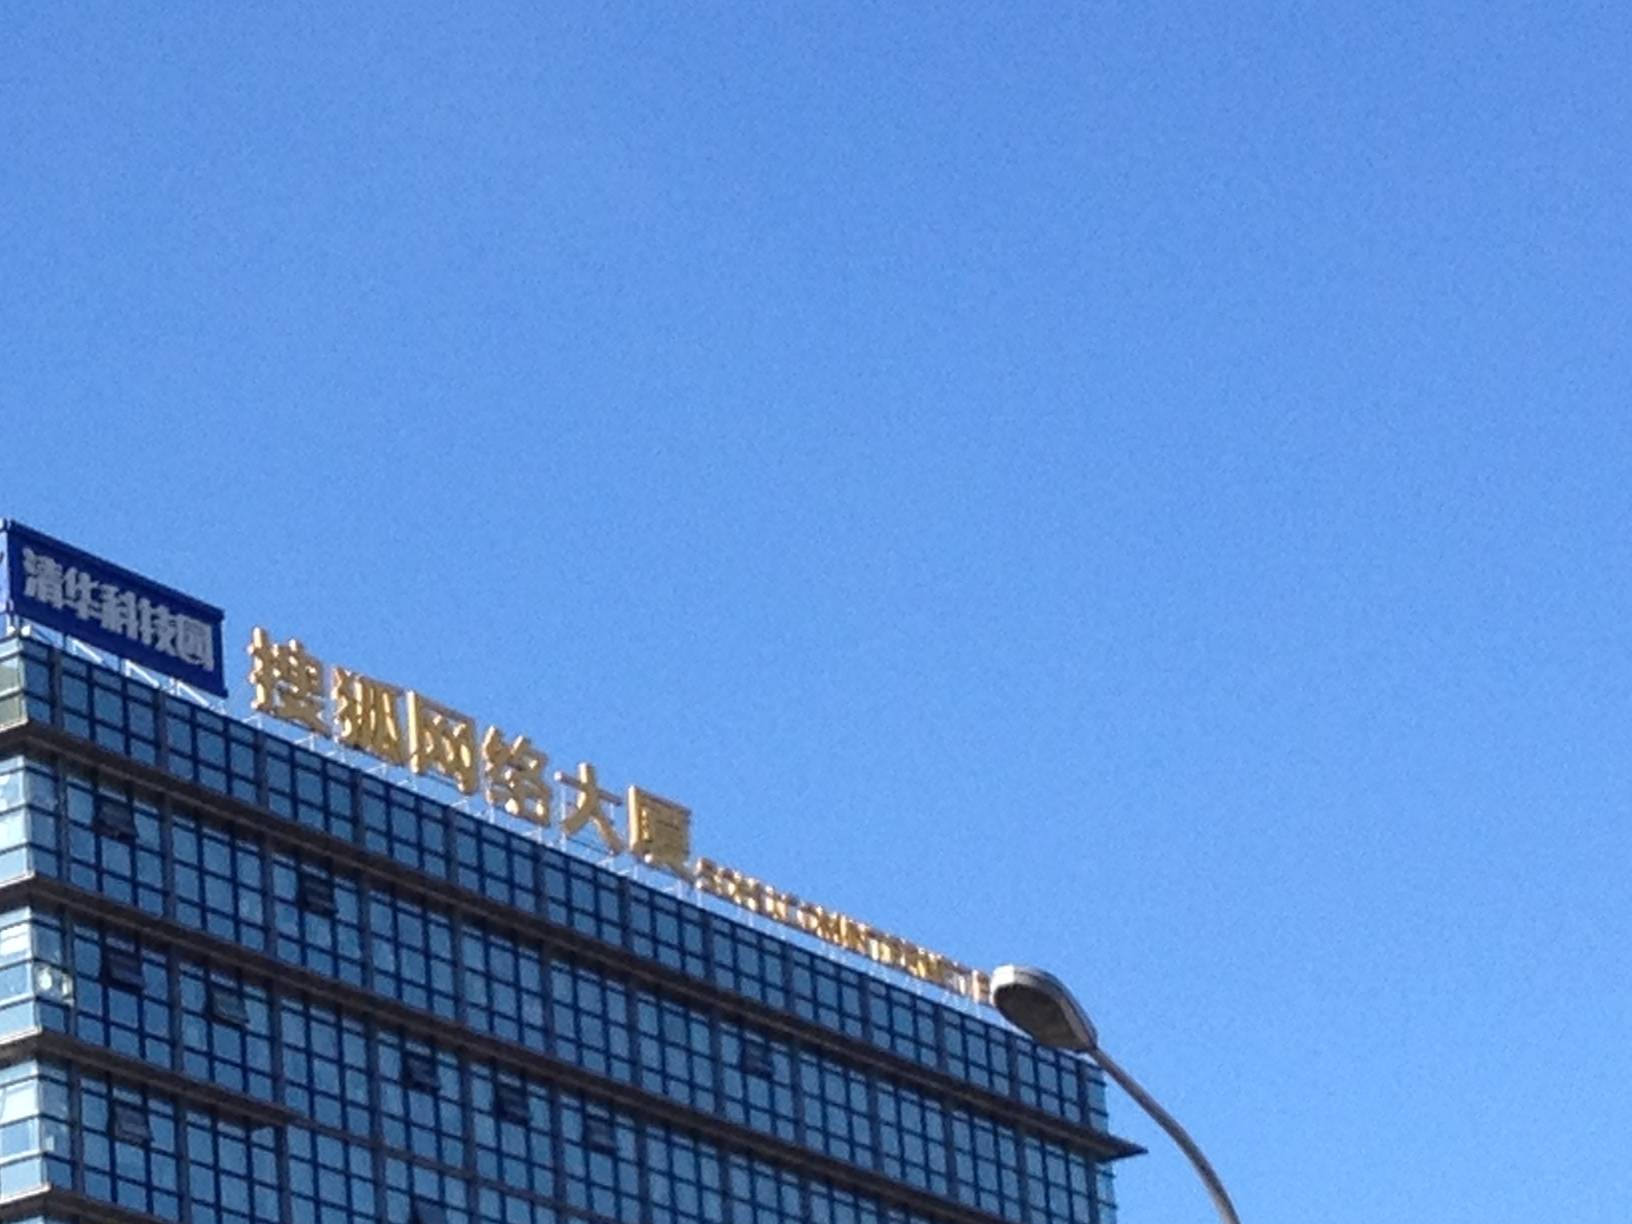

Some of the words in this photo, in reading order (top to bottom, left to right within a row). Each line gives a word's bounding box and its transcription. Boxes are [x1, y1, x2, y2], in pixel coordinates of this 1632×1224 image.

[22, 546, 215, 673] 清华科技园
[247, 626, 694, 878] 搜狐网络大厦
